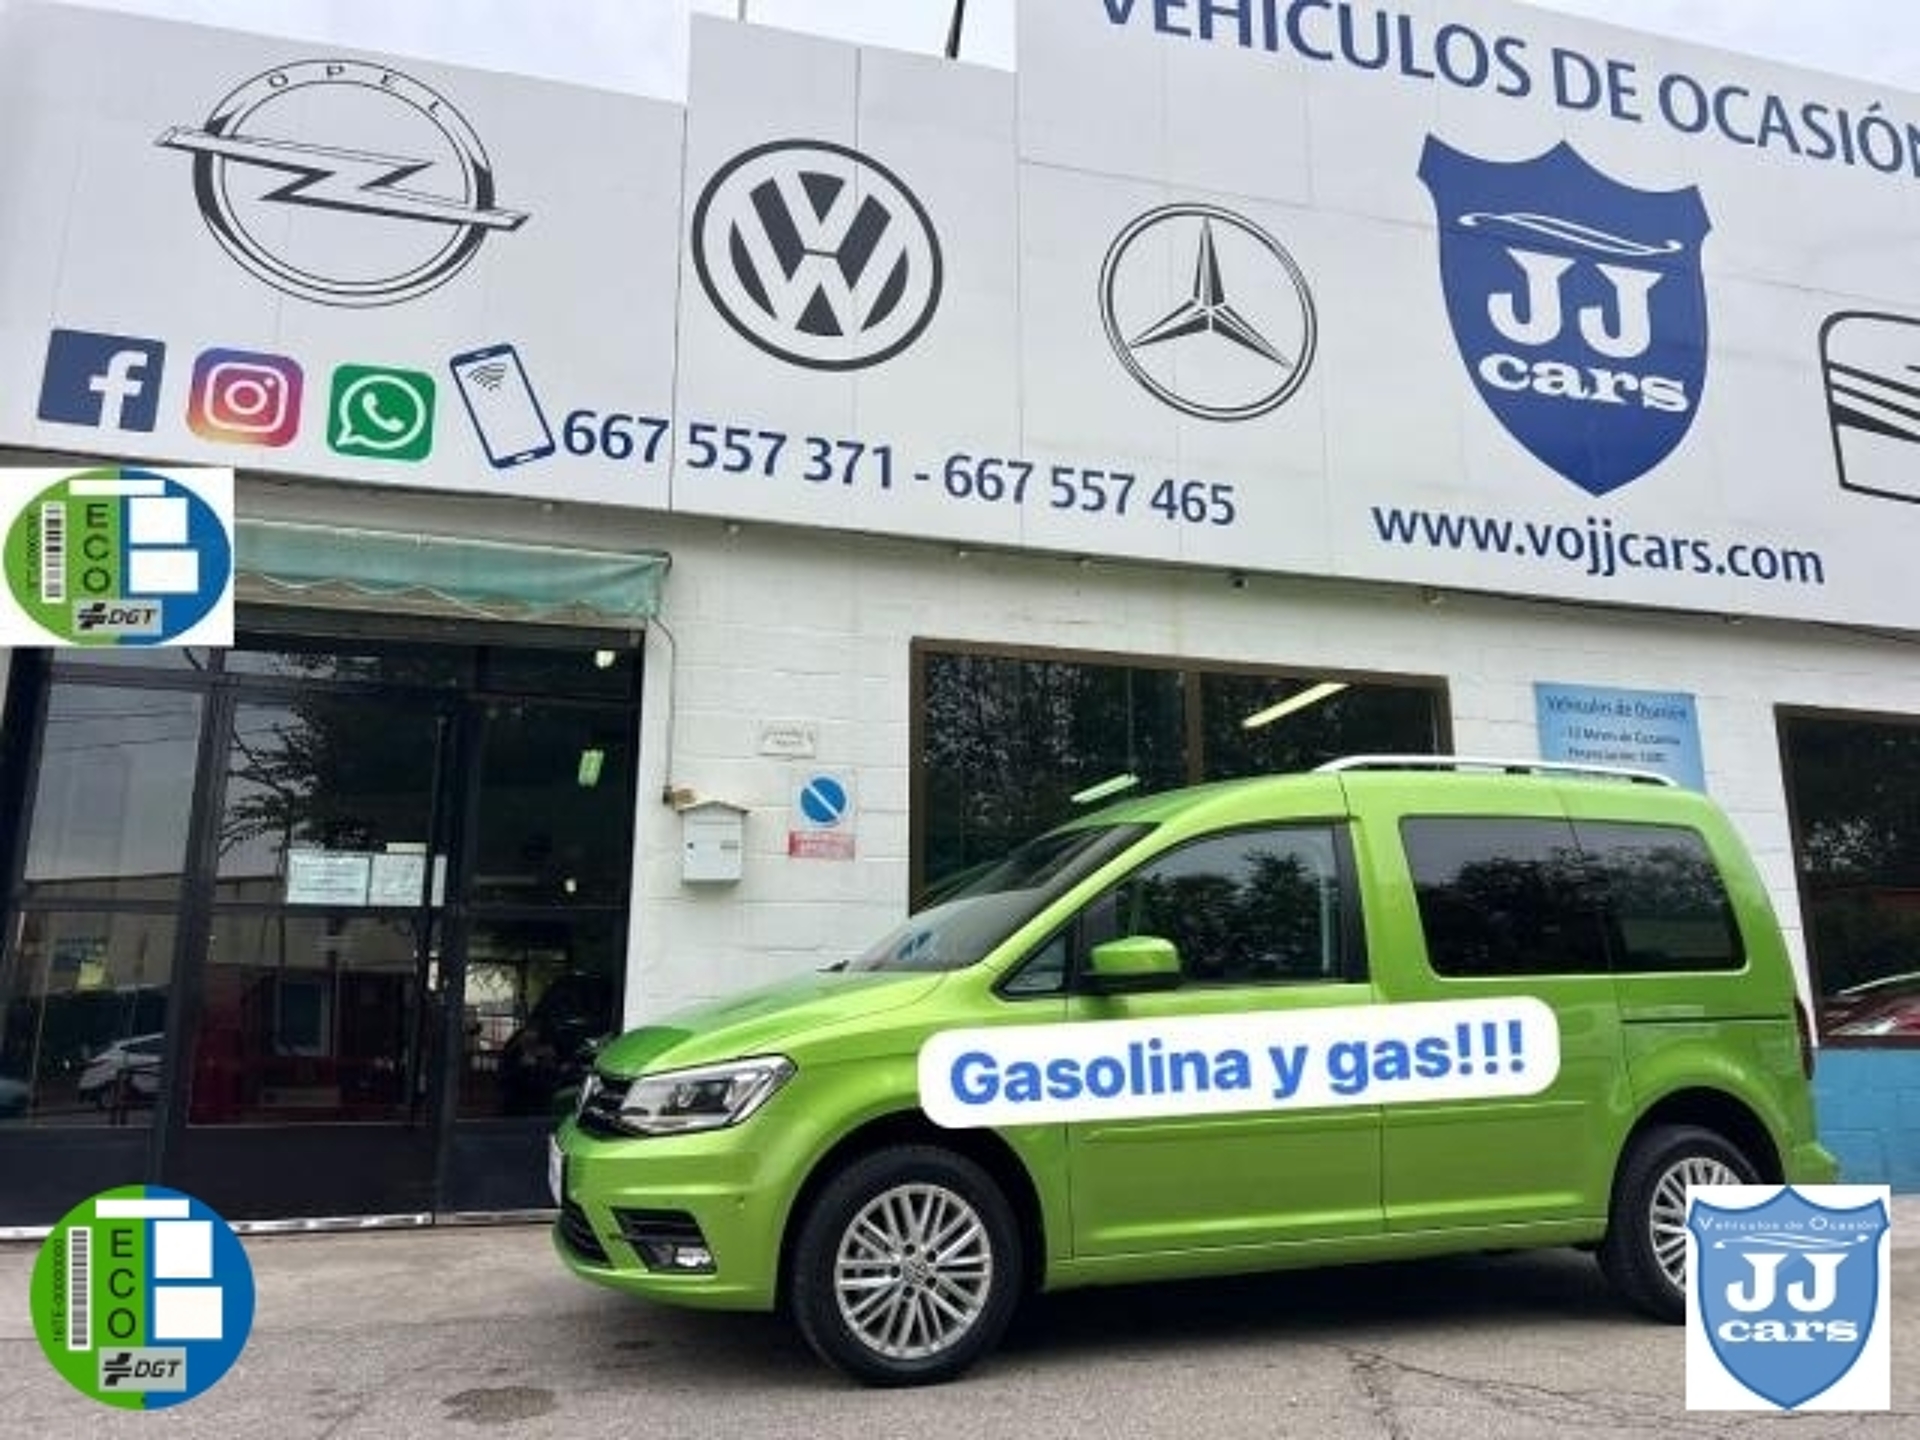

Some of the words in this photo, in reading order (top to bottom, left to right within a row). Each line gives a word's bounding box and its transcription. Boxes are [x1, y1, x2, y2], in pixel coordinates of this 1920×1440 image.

[268, 65, 441, 118] OPEL
[1552, 48, 1642, 121] DE
[1658, 74, 1920, 179] OCASIÓ
[1487, 248, 1663, 358] JJ
[1478, 353, 1690, 413] cars
[563, 410, 670, 463] 667
[686, 422, 787, 476] 557
[803, 437, 892, 489] 371
[944, 454, 1033, 504] 667
[1050, 467, 1135, 515] 557
[1150, 479, 1236, 526] 465
[1372, 505, 1825, 585] www.vojjcars.com
